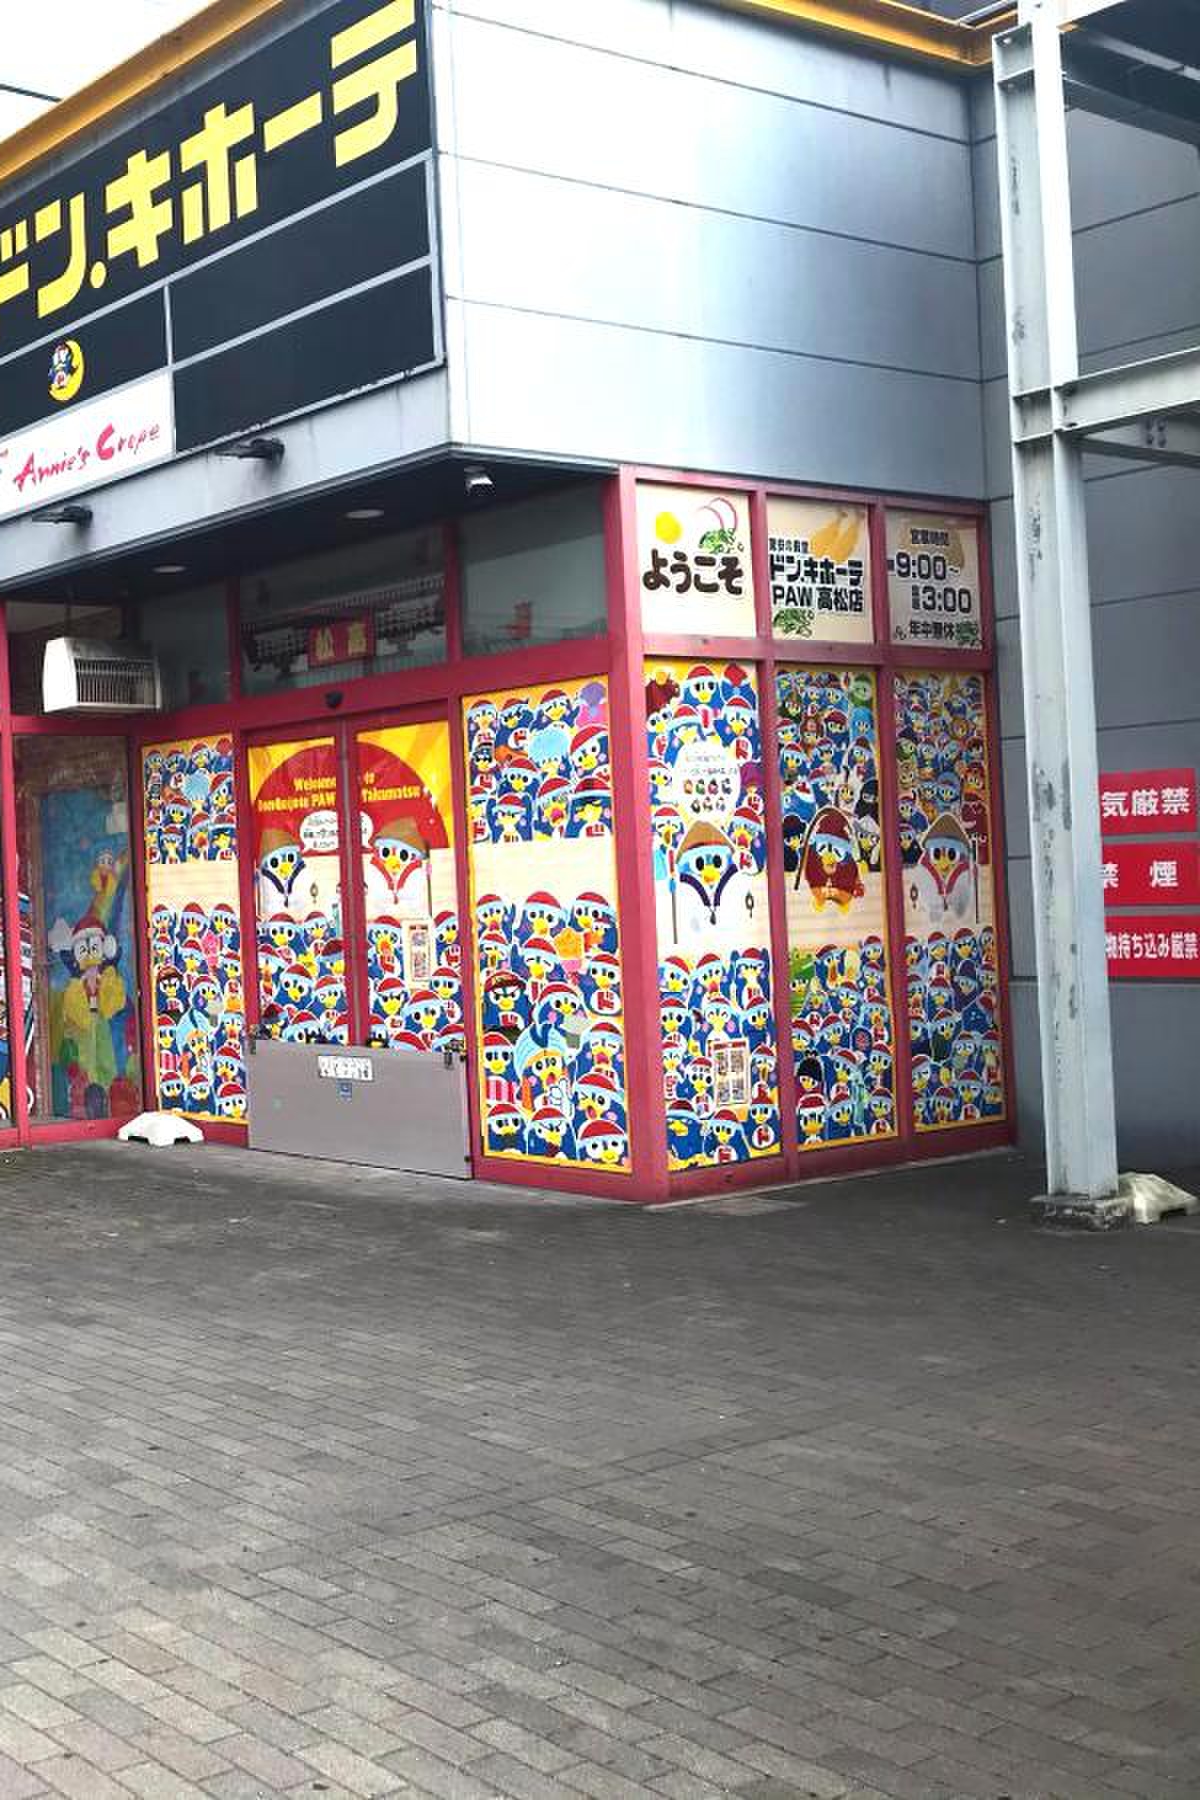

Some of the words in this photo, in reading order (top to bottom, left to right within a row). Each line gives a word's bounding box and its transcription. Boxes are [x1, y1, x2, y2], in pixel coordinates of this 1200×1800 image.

[642, 549, 744, 596] ようこそ
[772, 585, 814, 608] PAW
[816, 587, 864, 613] 高松店
